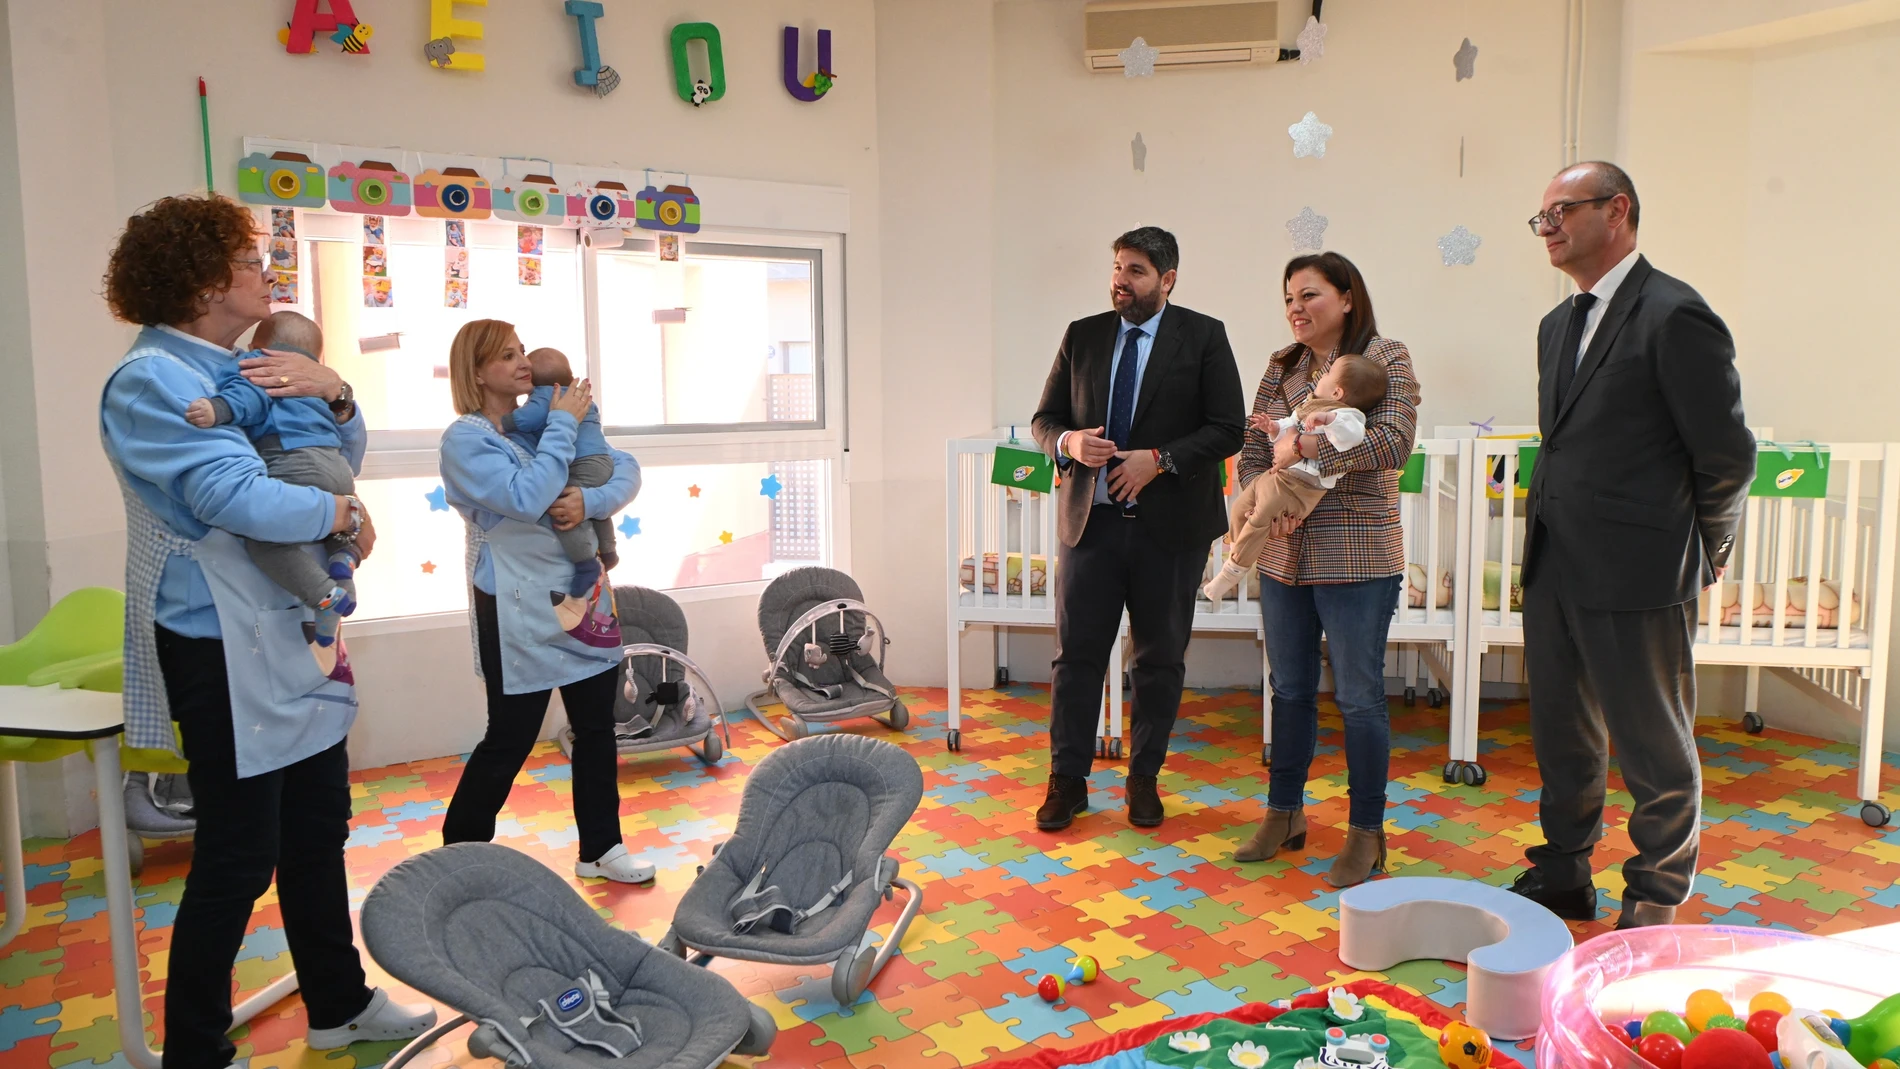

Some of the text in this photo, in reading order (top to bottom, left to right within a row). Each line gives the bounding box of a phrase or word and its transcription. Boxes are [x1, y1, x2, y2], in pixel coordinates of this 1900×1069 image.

[286, 0, 832, 102] A E I O U
